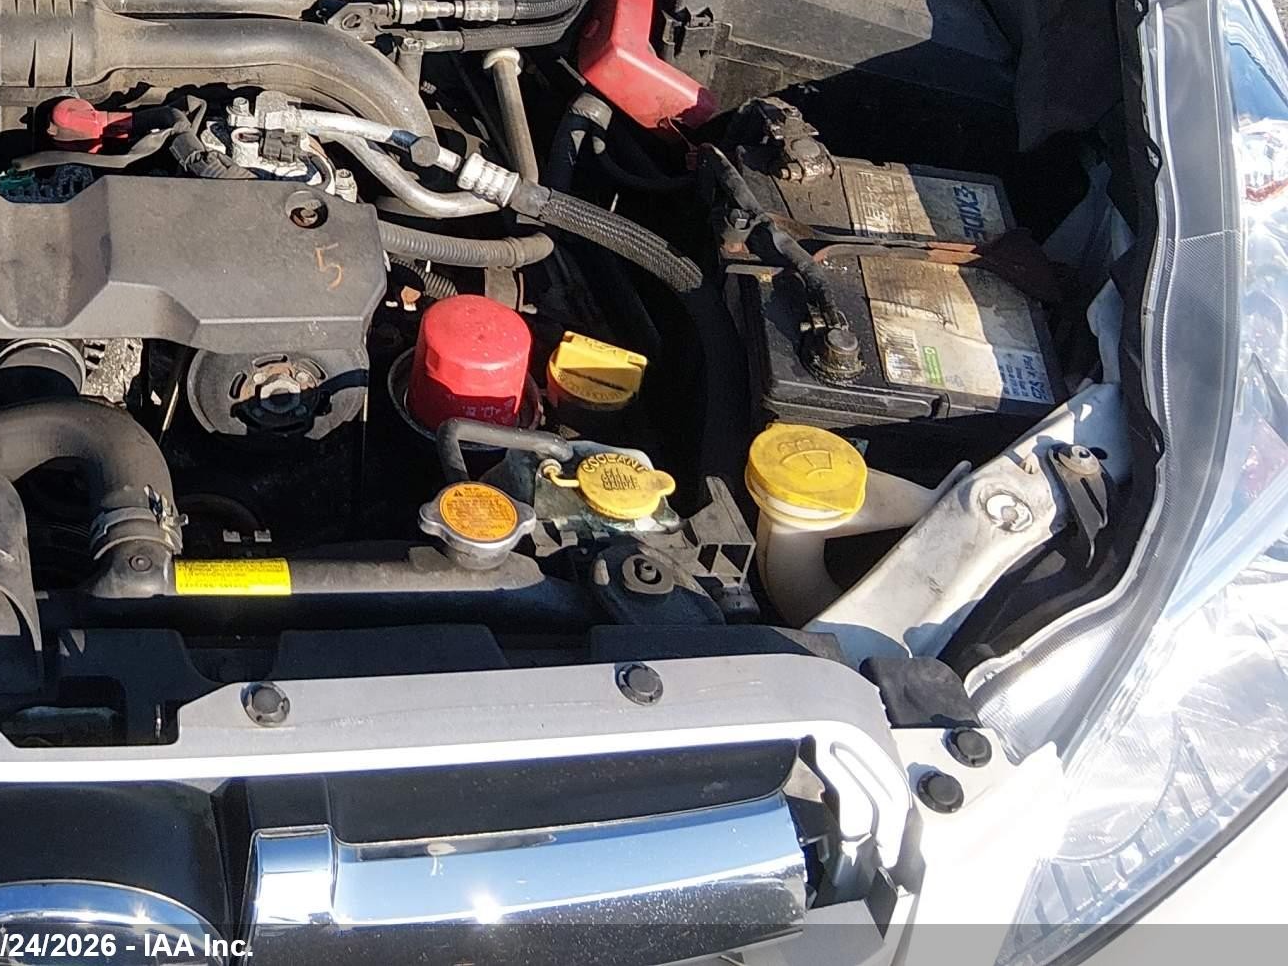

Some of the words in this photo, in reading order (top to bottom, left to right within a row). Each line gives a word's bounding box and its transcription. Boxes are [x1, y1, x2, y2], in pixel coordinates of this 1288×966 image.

[953, 185, 984, 242] EXIDE
[315, 242, 344, 291] 5
[581, 453, 650, 474] COOLANT
